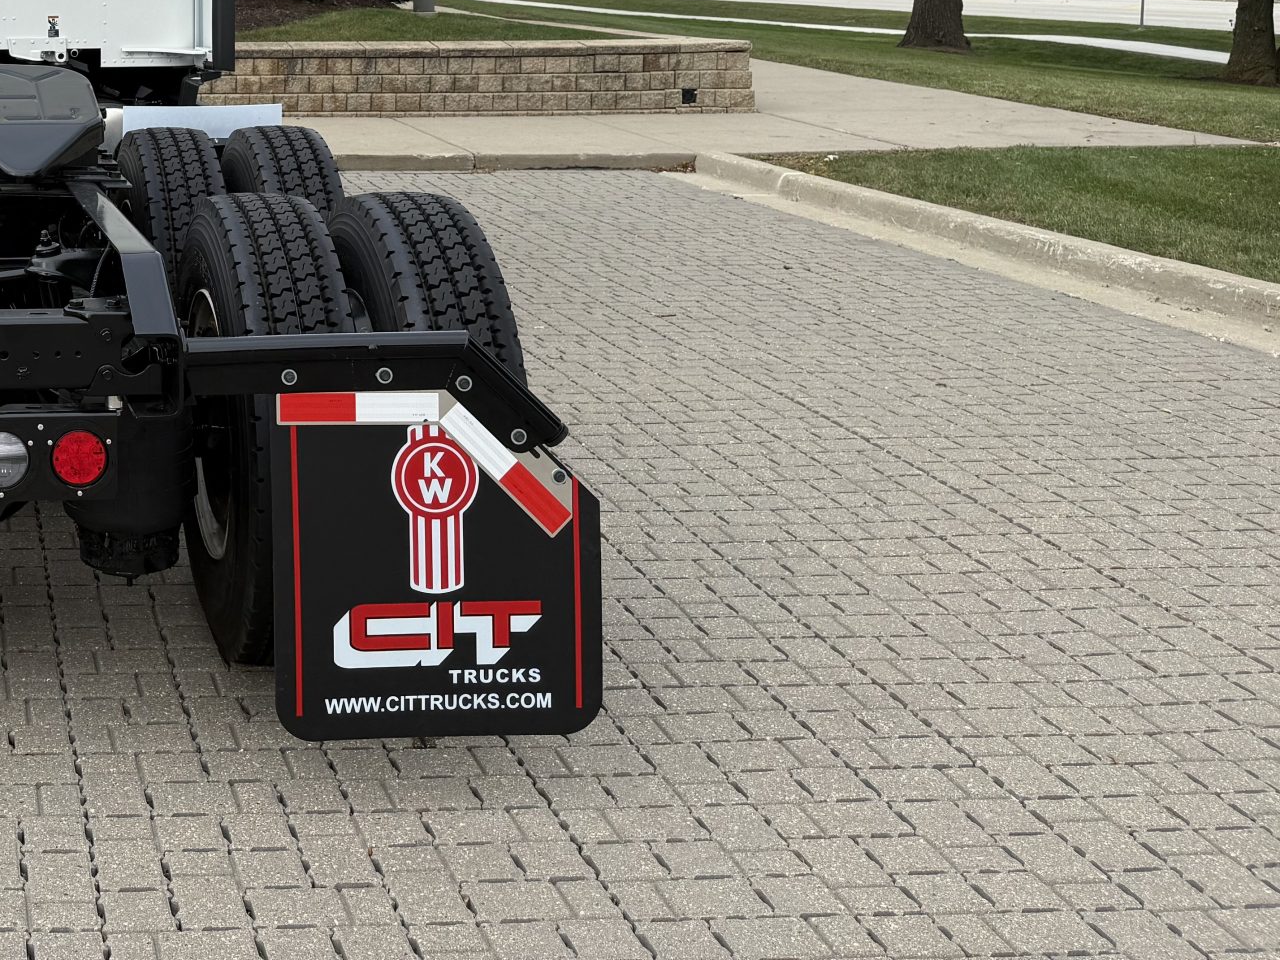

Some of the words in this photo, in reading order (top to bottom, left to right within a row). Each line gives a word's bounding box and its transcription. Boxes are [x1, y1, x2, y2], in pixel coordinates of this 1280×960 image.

[333, 600, 542, 669] CIT
[449, 668, 541, 683] TRUCKS
[325, 692, 552, 715] WWW.CITTRUCKS.COM
